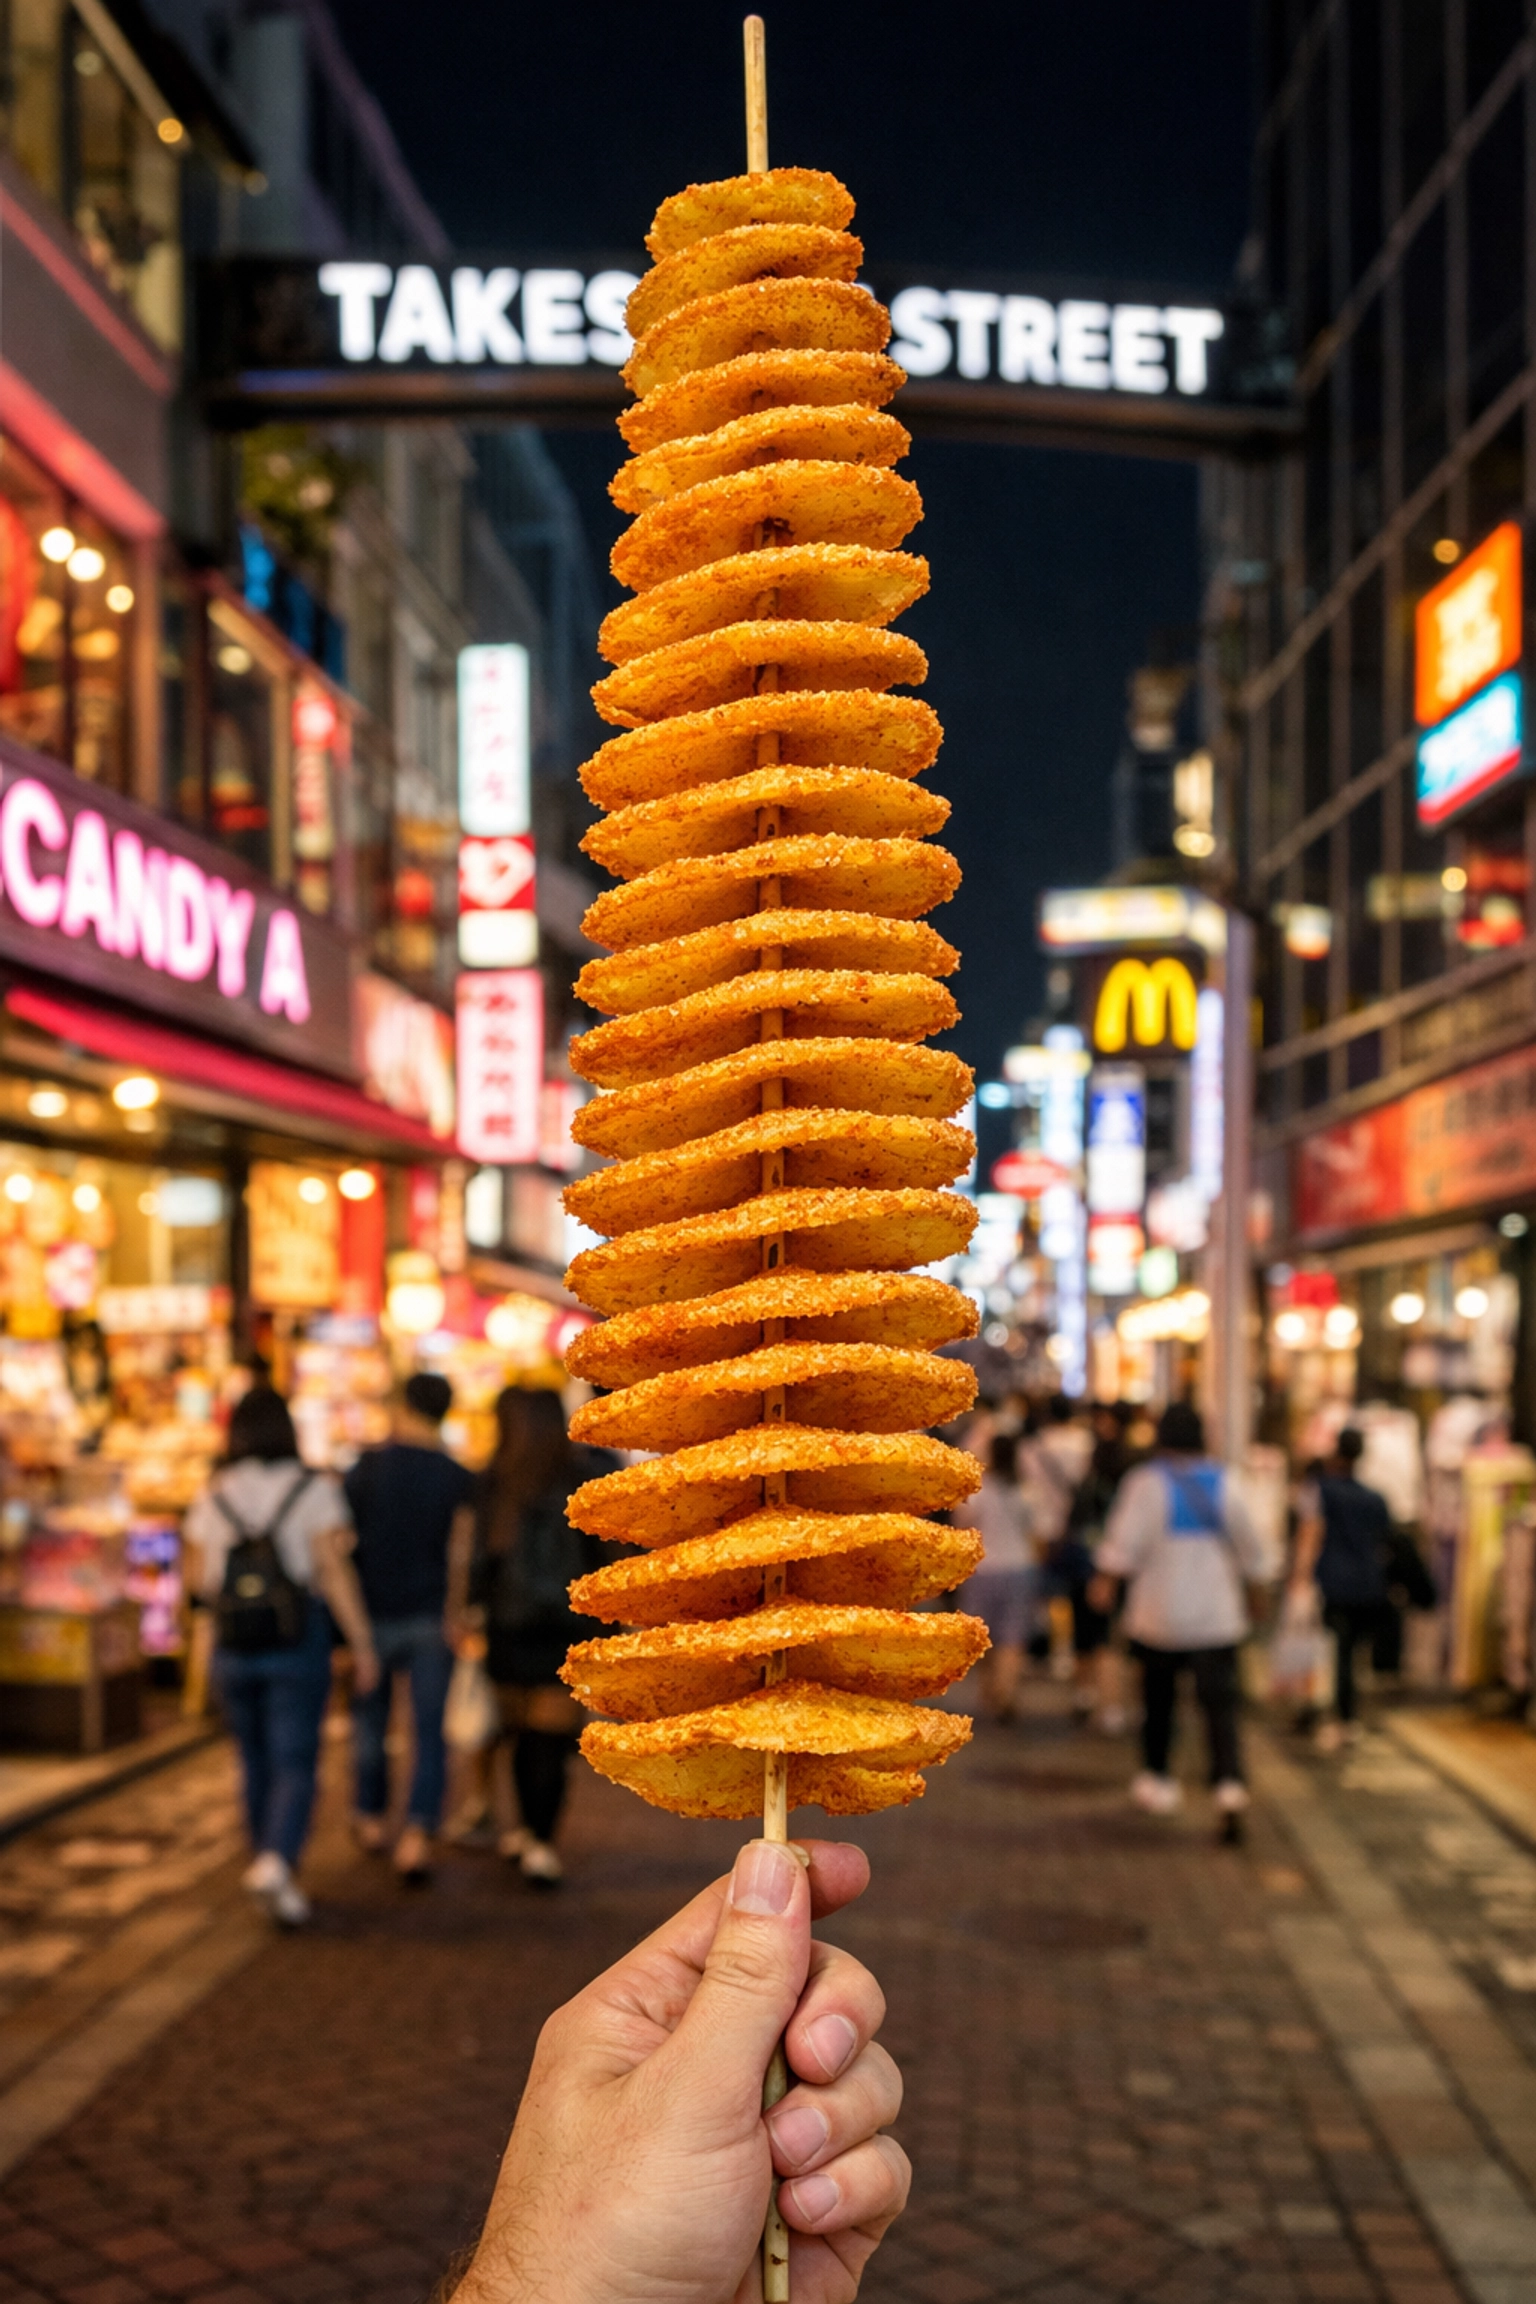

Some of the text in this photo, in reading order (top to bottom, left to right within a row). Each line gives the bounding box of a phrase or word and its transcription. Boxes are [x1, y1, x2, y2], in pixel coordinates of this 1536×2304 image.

[318, 262, 1224, 396] TAKES STREET
[1, 777, 255, 998] CANDY
[260, 908, 312, 1025] A
